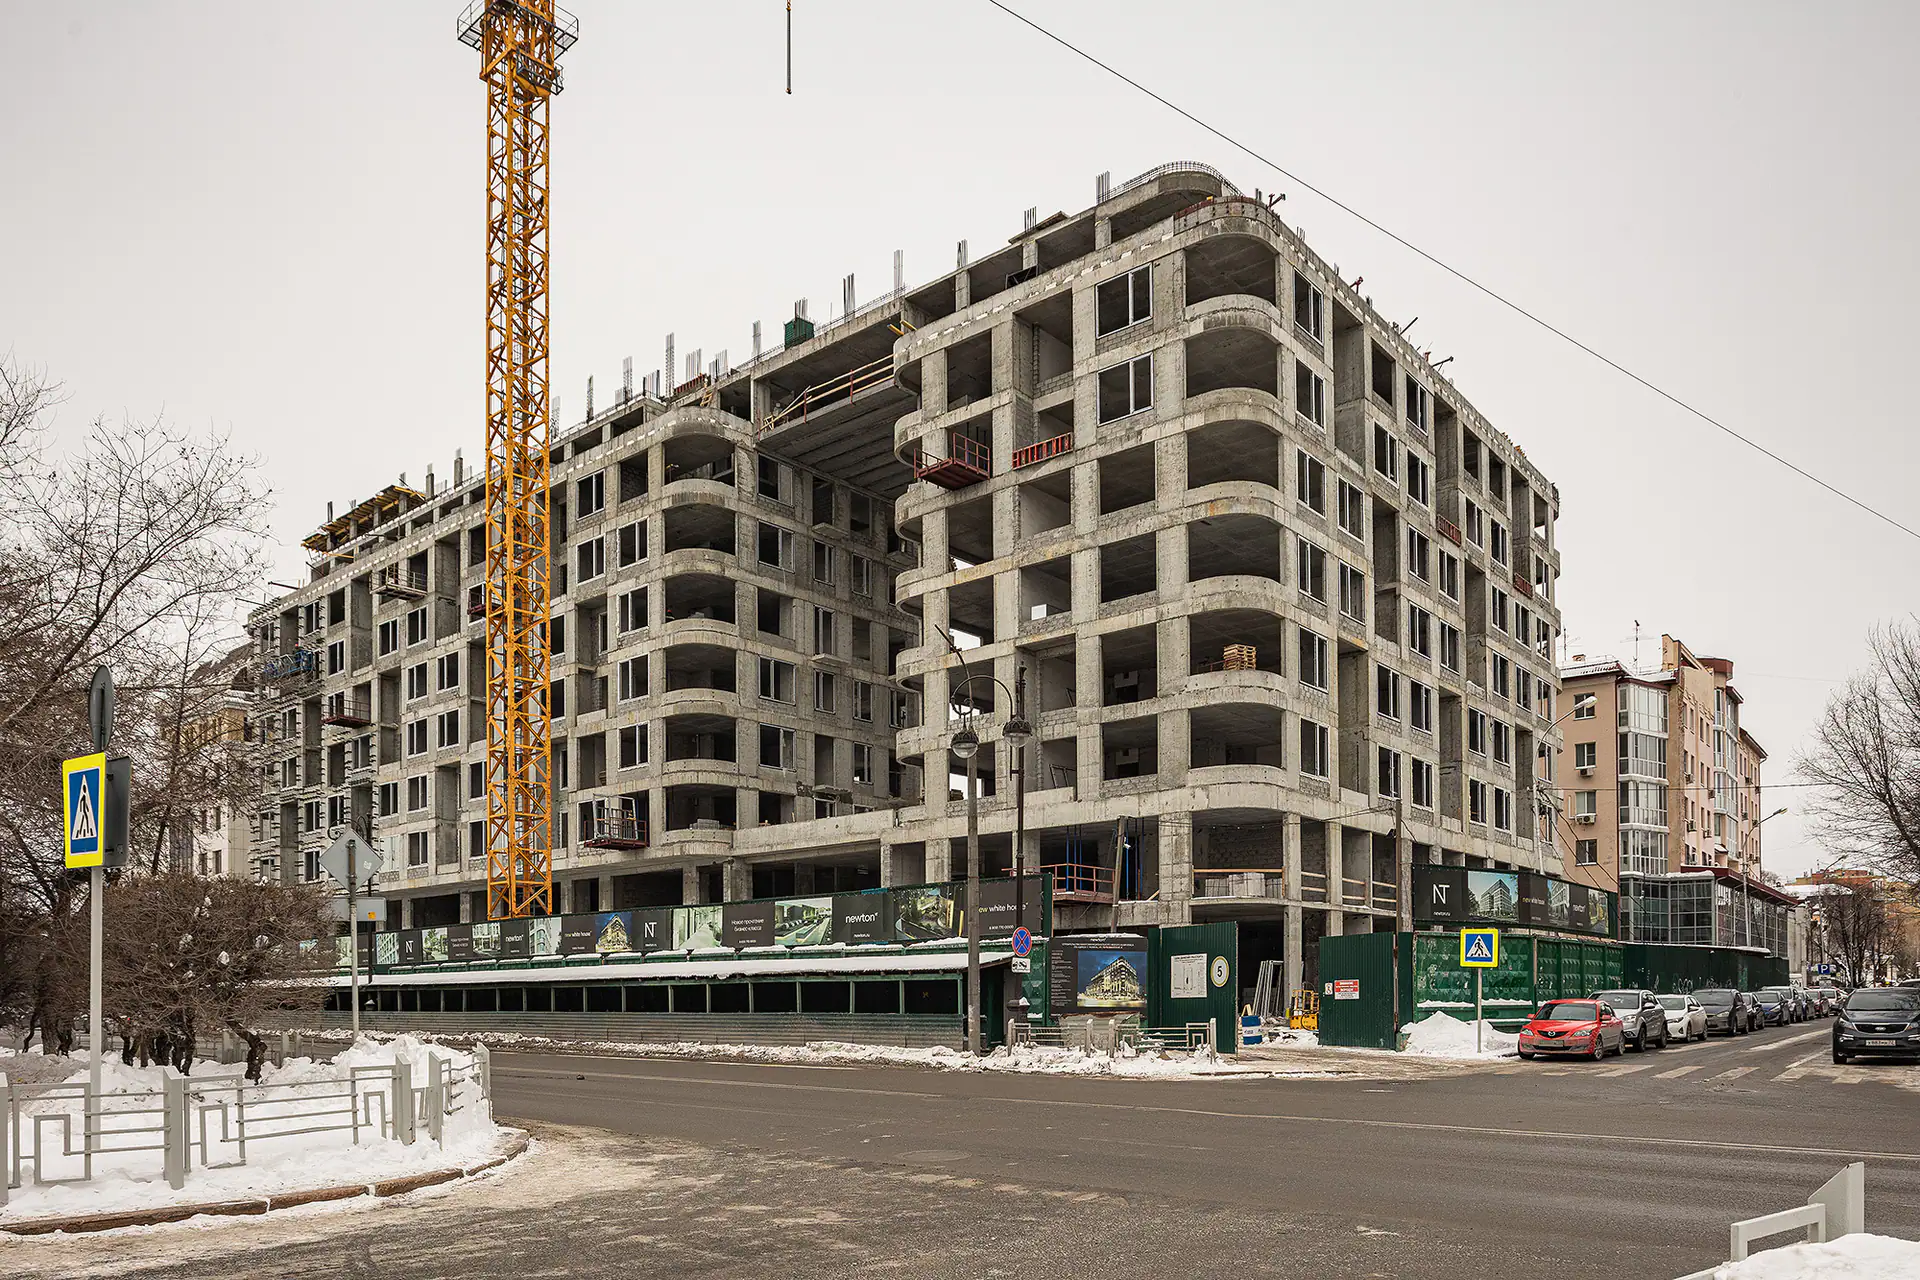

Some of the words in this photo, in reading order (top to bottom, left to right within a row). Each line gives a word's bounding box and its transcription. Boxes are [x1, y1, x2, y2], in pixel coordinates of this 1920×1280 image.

[1433, 884, 1450, 904] NT
[989, 904, 1006, 912] white
[845, 913, 876, 923] newton
[644, 922, 657, 938] NT
[405, 940, 414, 954] NT
[1217, 965, 1223, 978] 5
[1821, 965, 1828, 974] P
